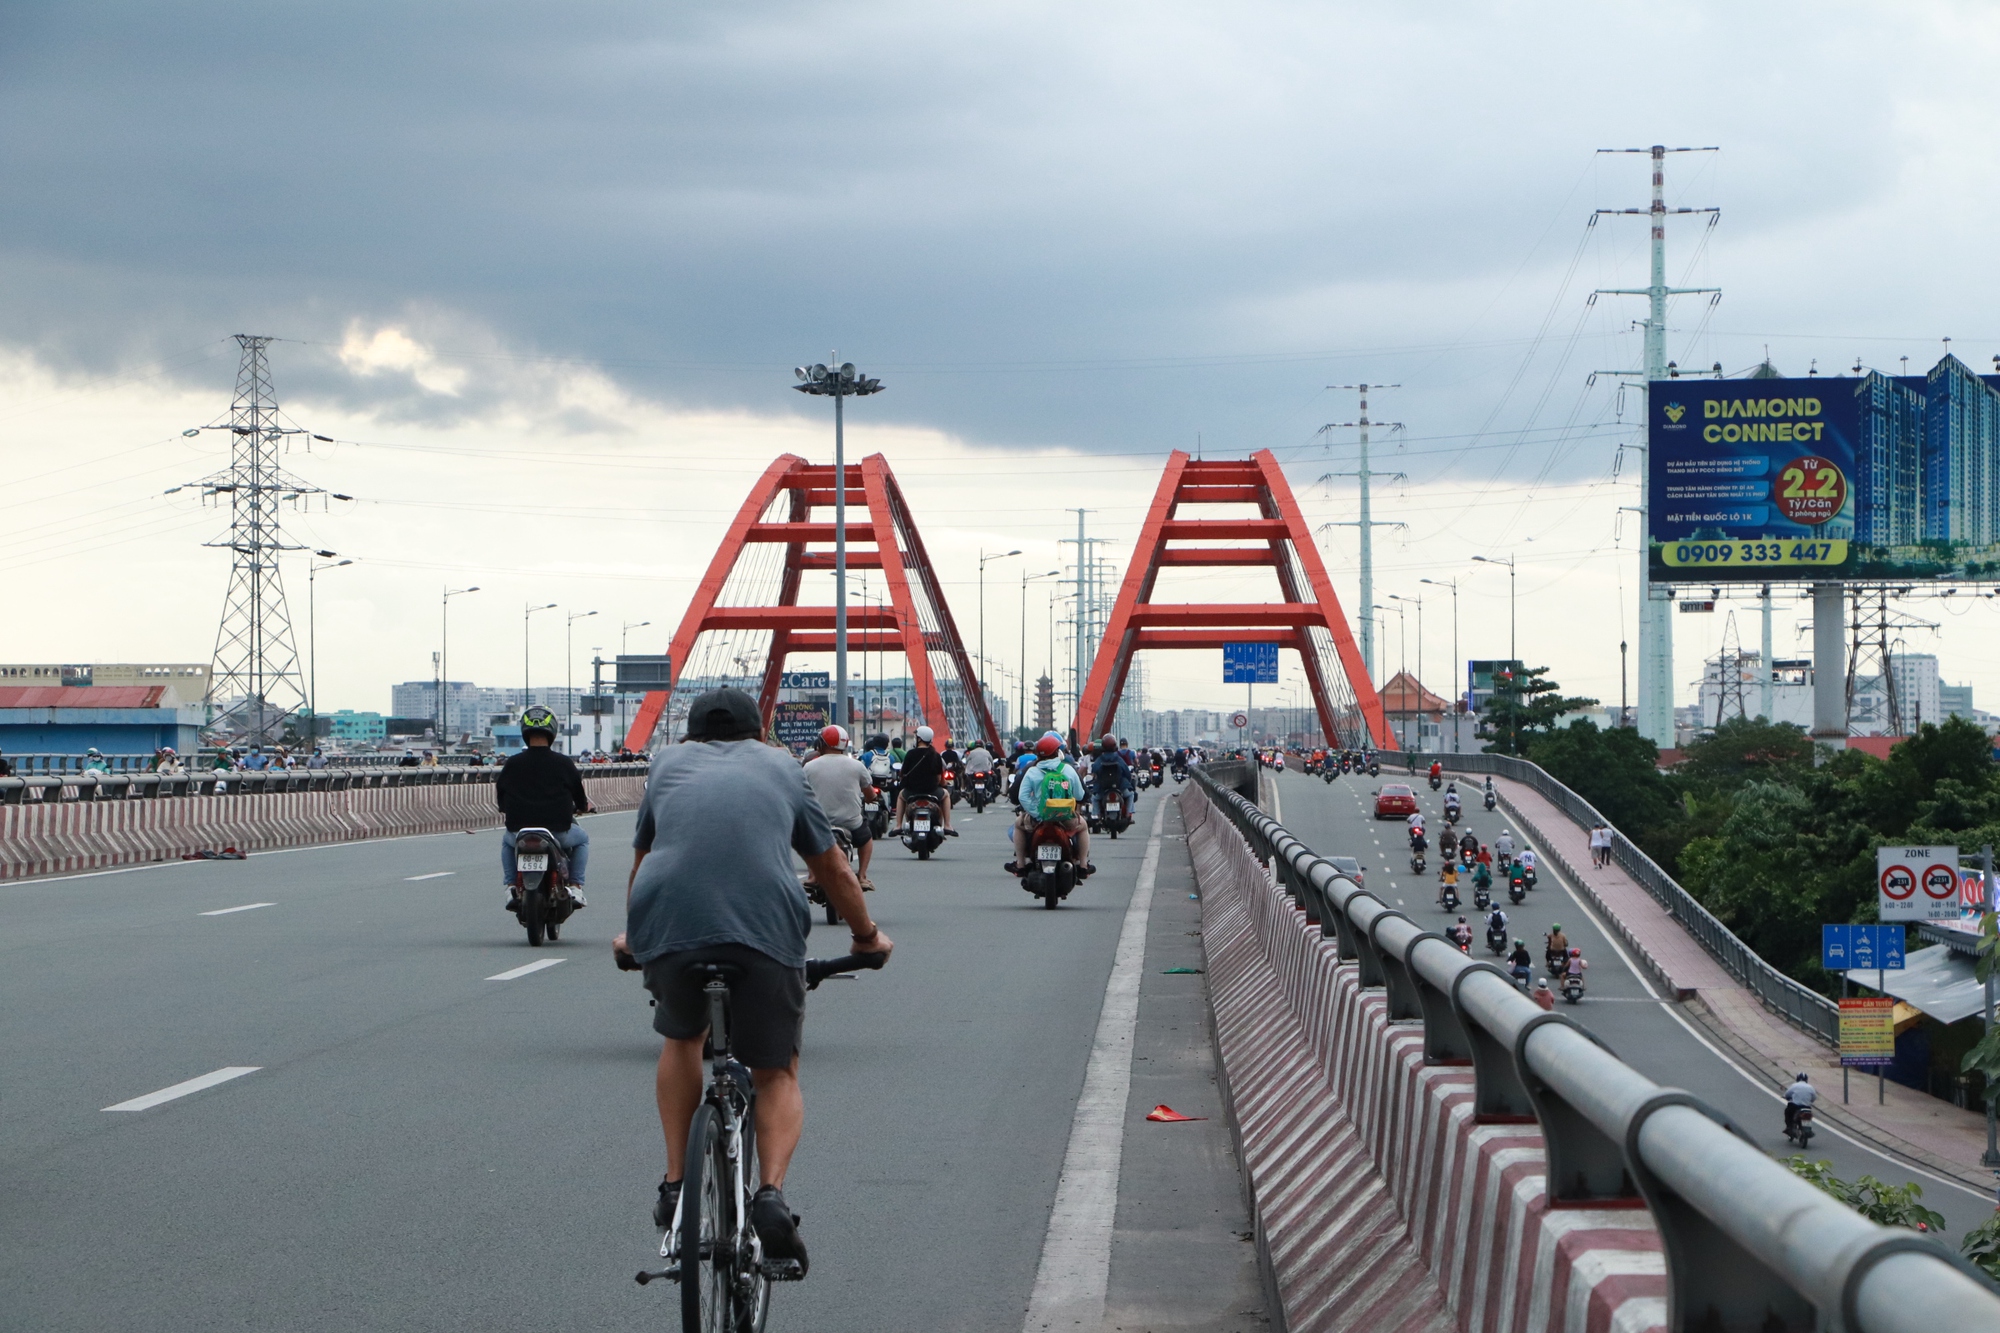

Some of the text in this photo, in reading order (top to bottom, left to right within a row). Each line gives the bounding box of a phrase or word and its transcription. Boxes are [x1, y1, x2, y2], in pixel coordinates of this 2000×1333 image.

[1704, 398, 1822, 418] DIAMOND
[1703, 422, 1824, 443] CONNECT
[1803, 459, 1818, 469] Từ
[1783, 468, 1838, 498] 2.2
[1667, 514, 1684, 523] MẶT
[1686, 512, 1701, 521] TIỀN
[1703, 512, 1727, 521] QUỐC
[1730, 513, 1739, 522] LỘ
[1677, 544, 1832, 562] 0909 333 447
[780, 674, 826, 688] r.Care
[1905, 849, 1930, 858] ZONE
